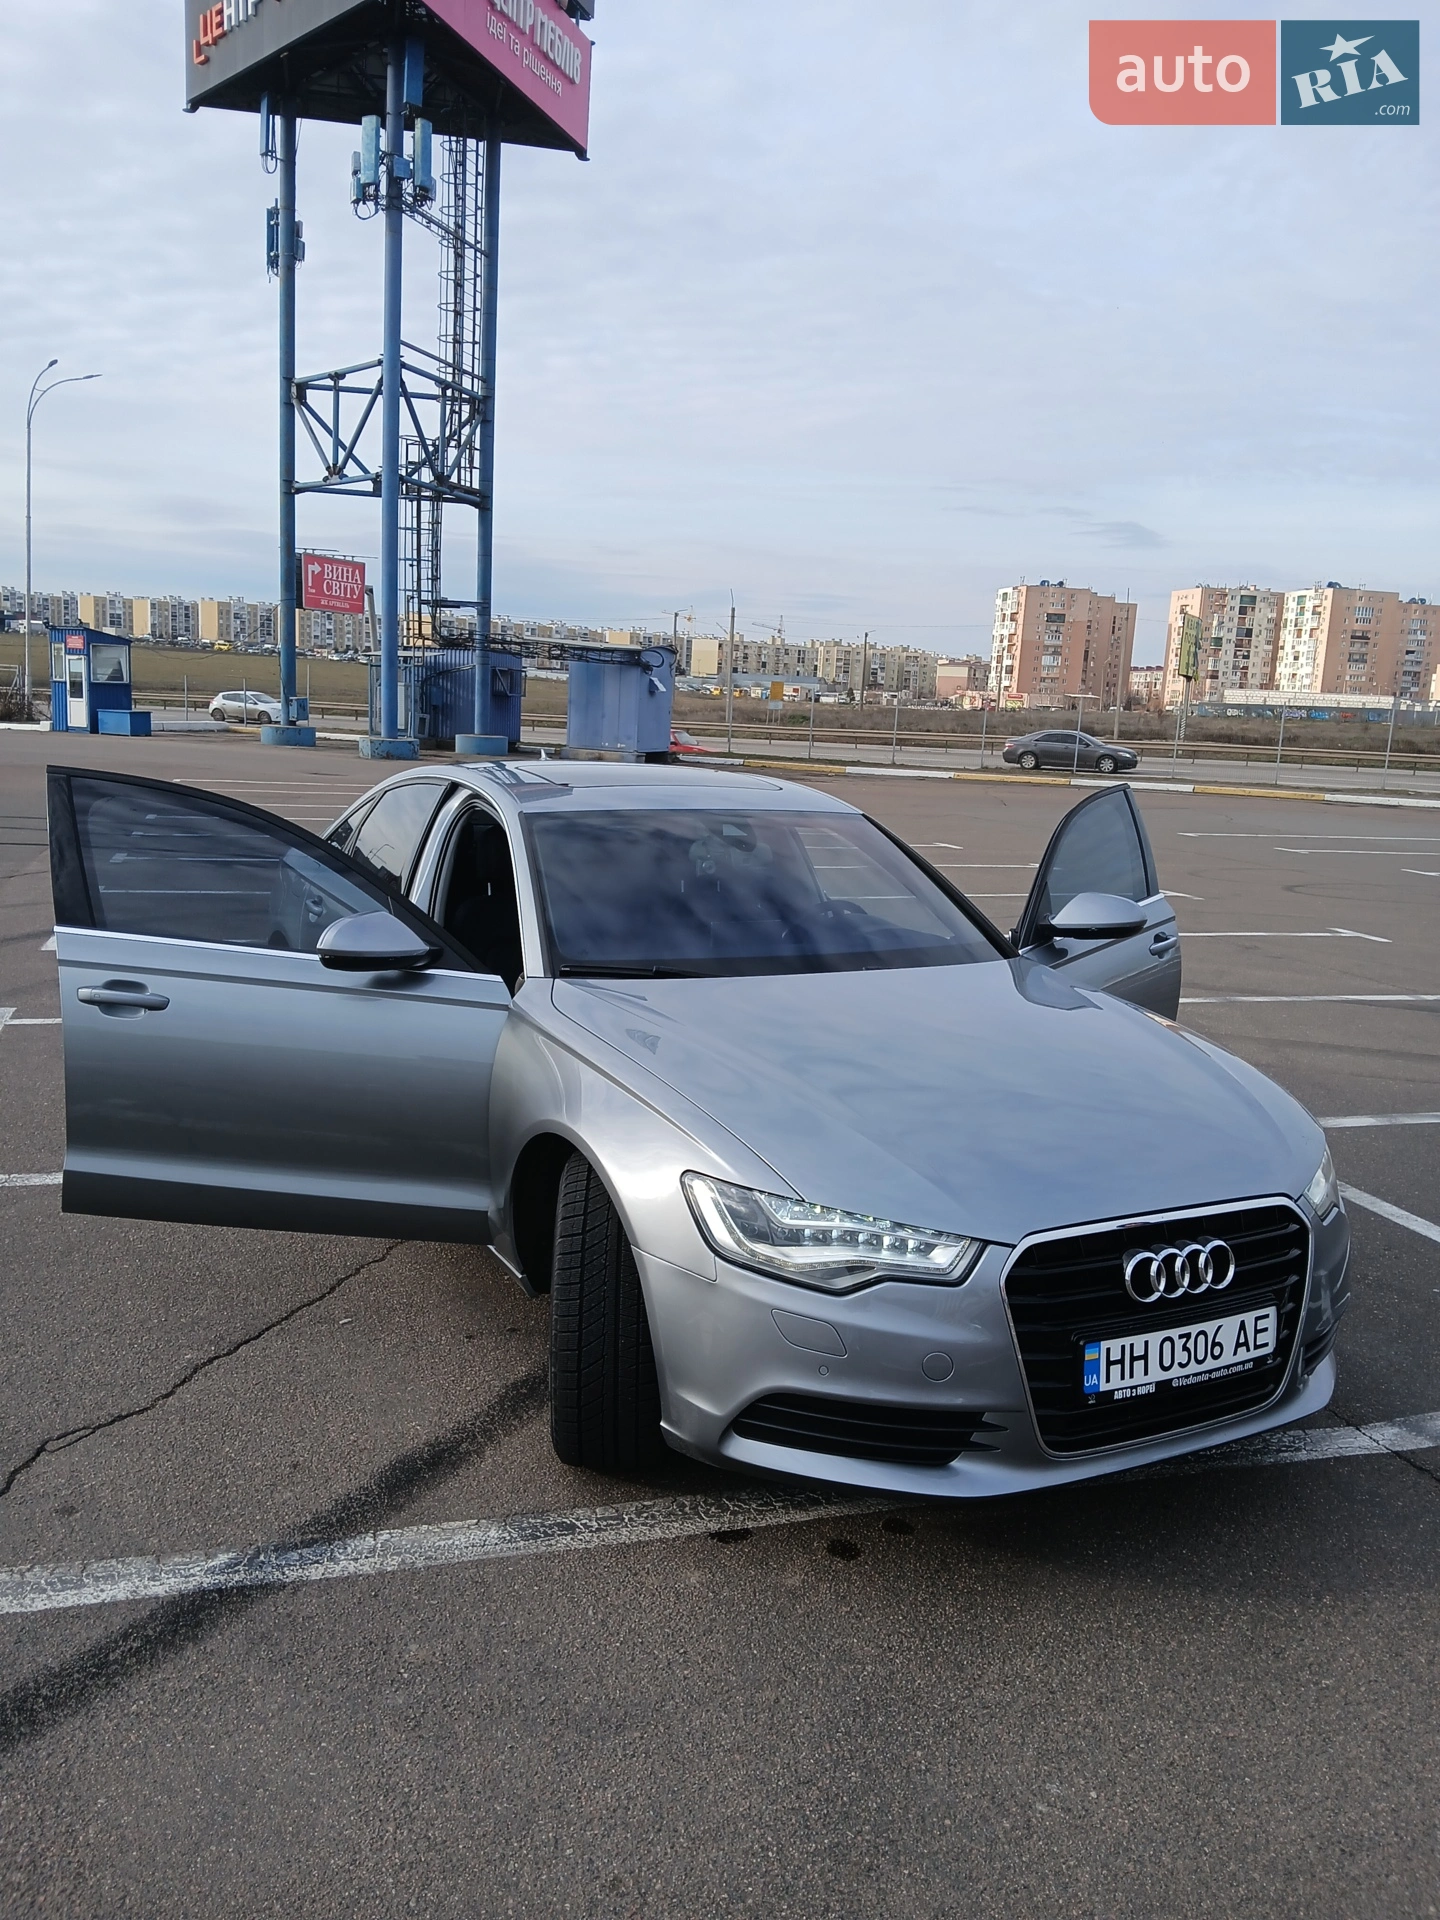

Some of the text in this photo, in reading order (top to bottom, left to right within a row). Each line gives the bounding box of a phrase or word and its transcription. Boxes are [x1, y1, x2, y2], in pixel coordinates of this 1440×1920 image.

[486, 6, 562, 97] ідеї та рішення
[533, 7, 582, 85] МЕБЛІВ
[323, 563, 362, 584] ВИНА
[323, 580, 362, 598] СВІТУ
[1105, 1313, 1271, 1384] HH 0306 AE
[1083, 1374, 1098, 1387] UA
[1171, 1361, 1254, 1388] @Vedanta-auto.com.ua
[1113, 1387, 1131, 1400] АВТО
[1136, 1382, 1156, 1396] КОРЕЇ
